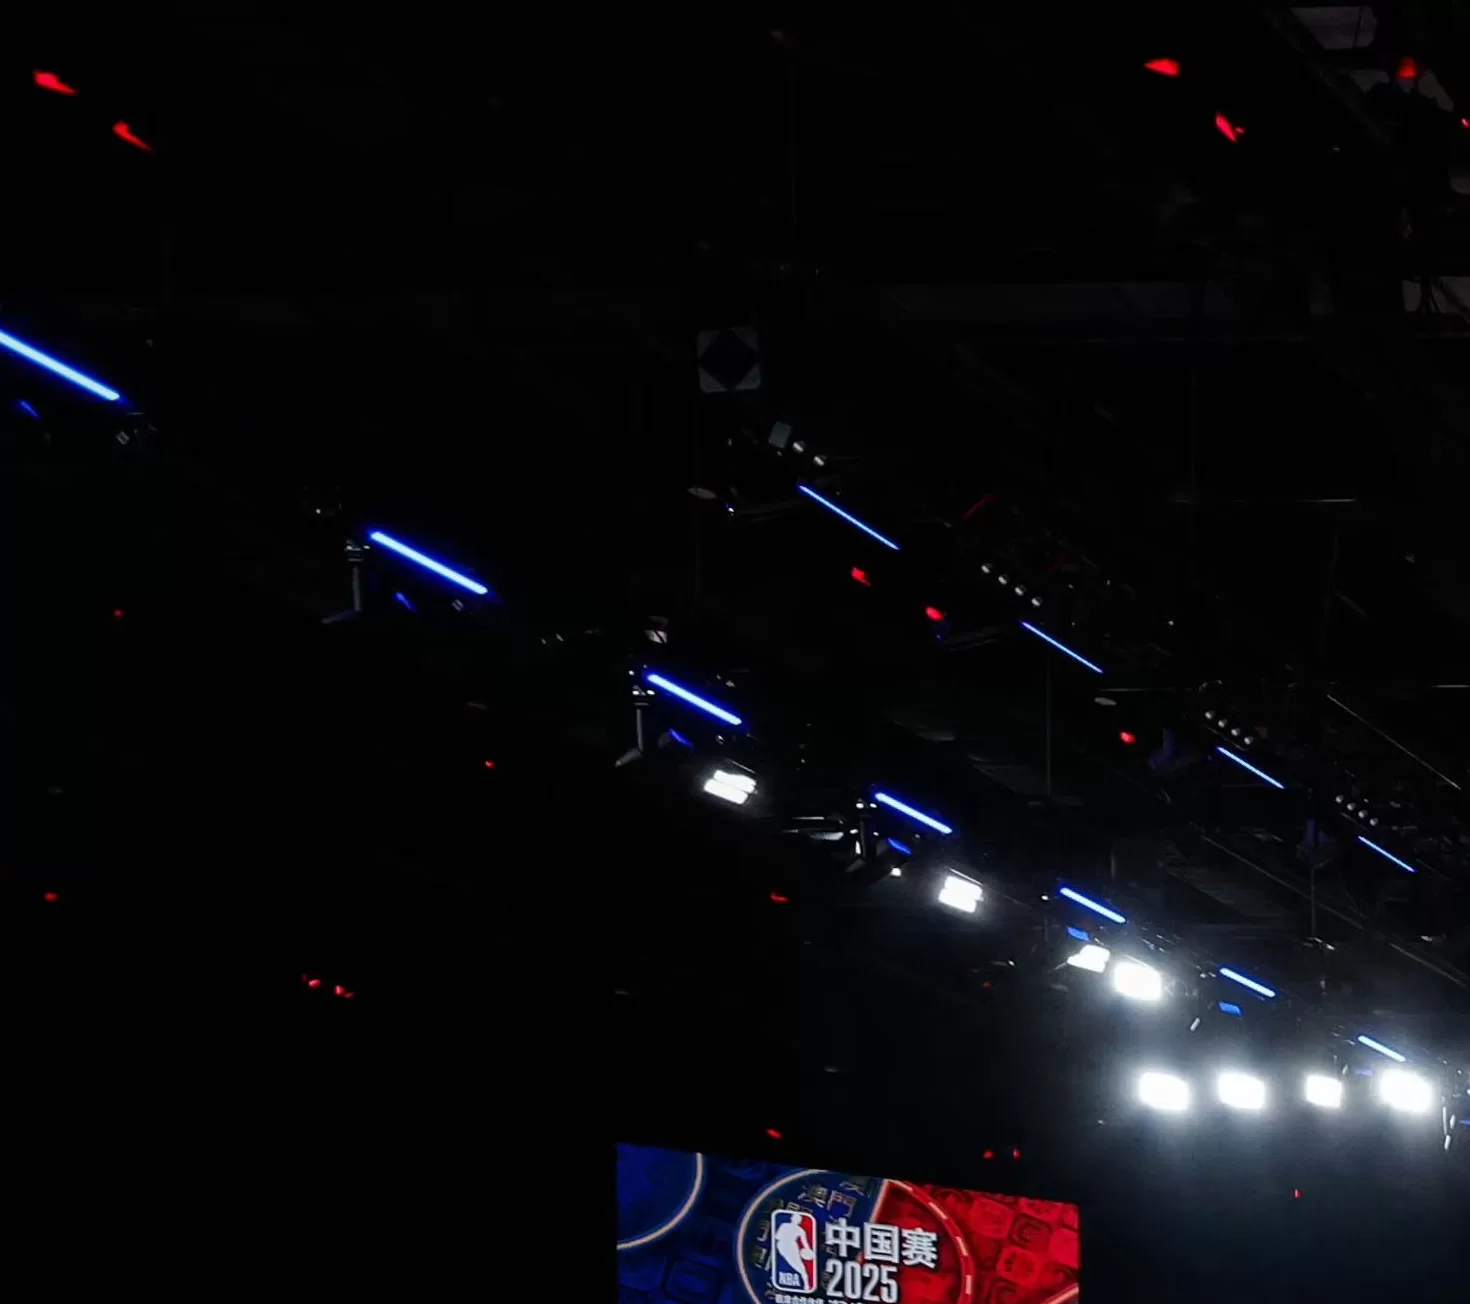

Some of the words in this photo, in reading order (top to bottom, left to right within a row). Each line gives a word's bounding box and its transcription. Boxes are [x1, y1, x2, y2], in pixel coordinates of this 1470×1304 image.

[825, 1217, 938, 1269] 中国赛
[825, 1259, 899, 1304] 2025
